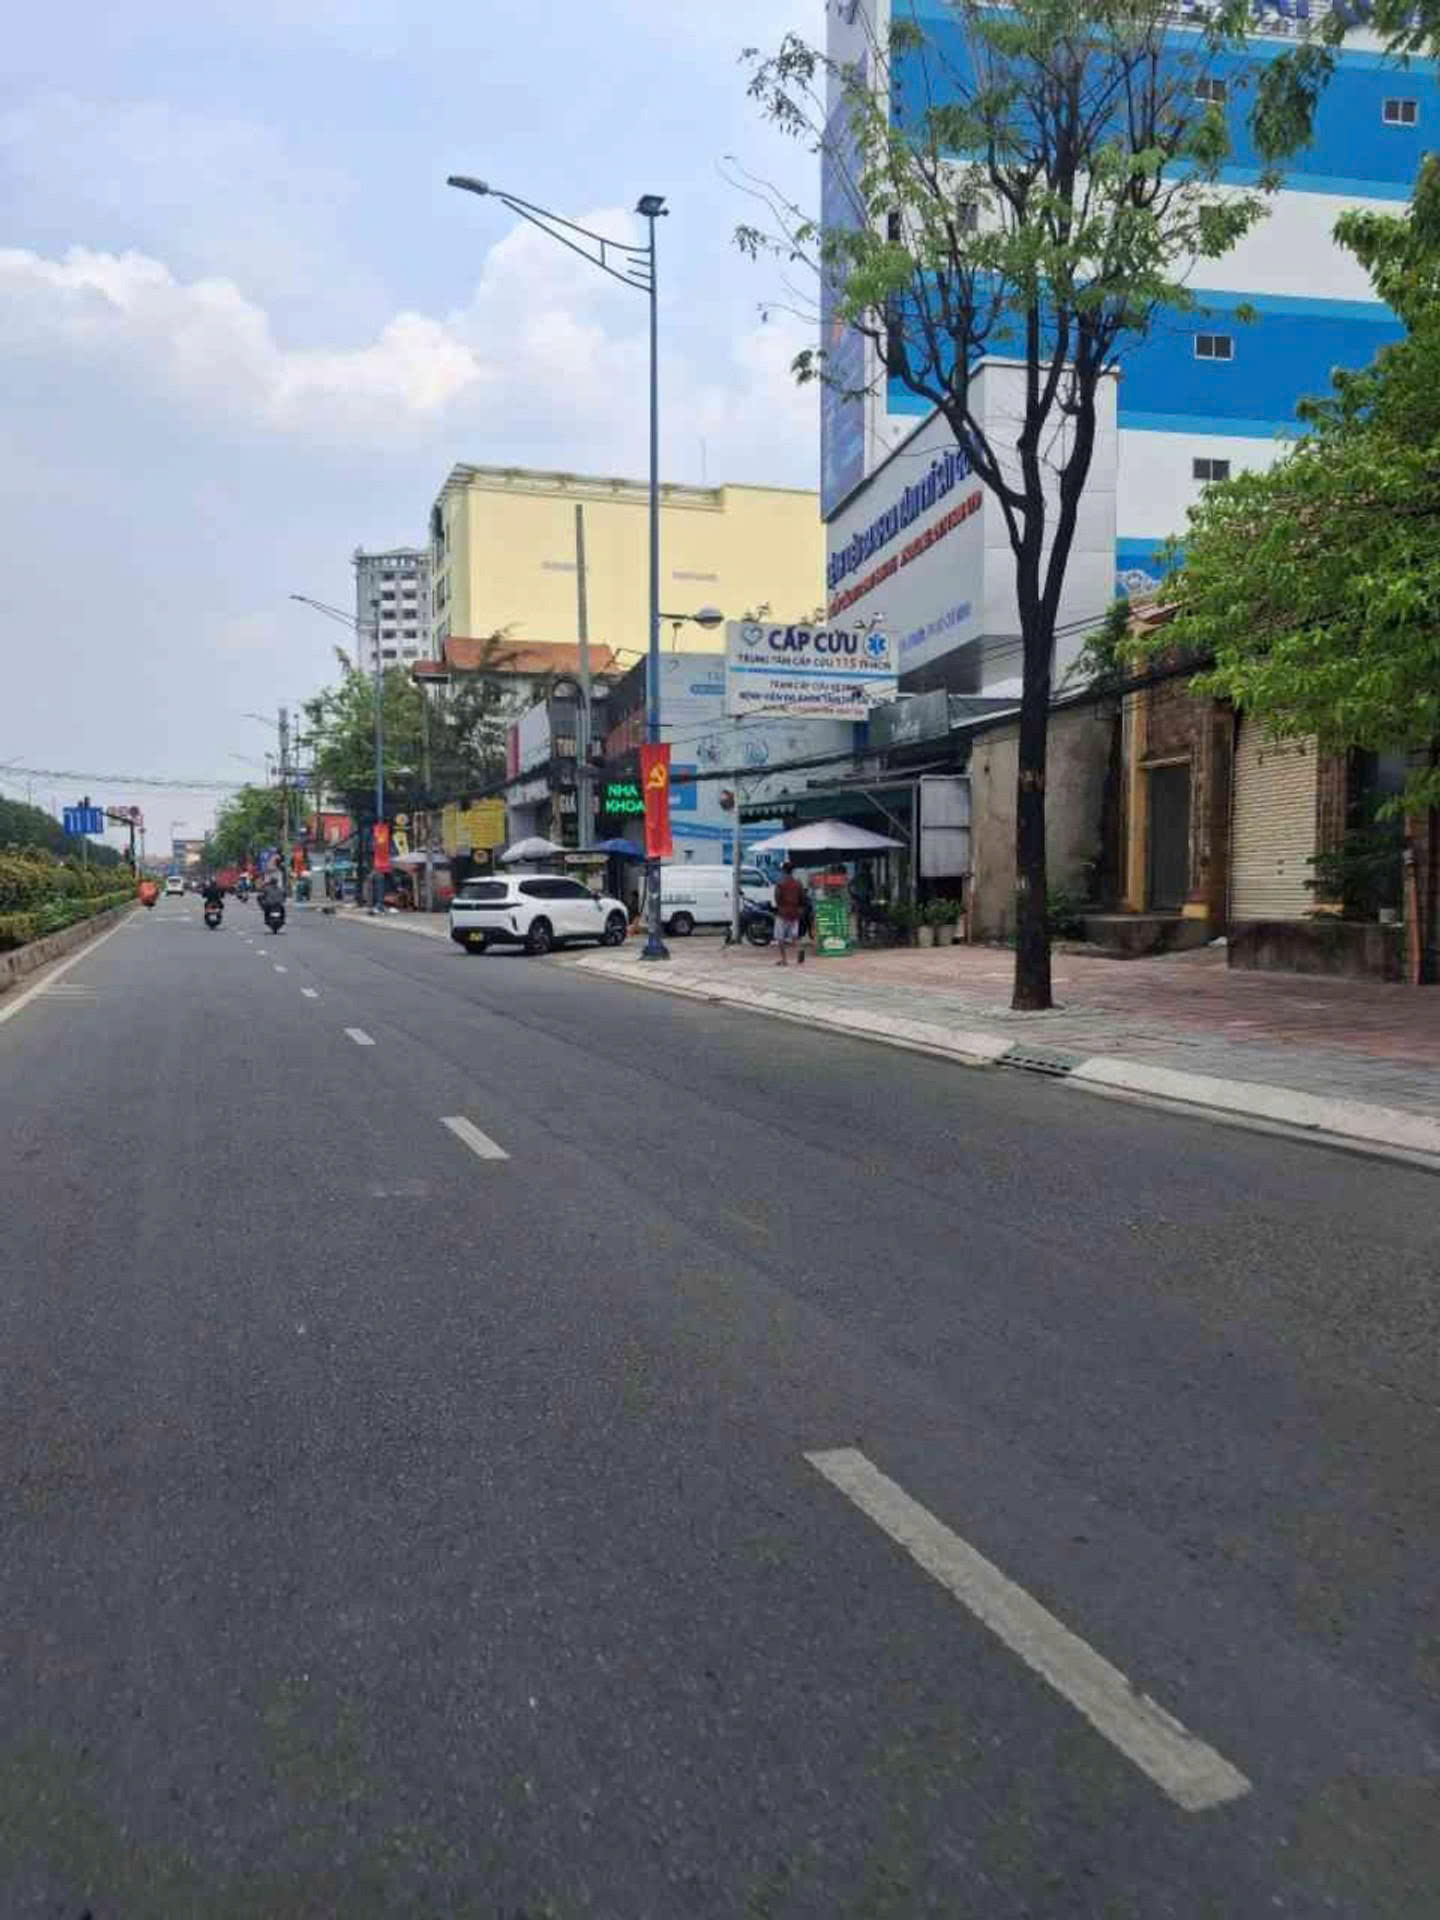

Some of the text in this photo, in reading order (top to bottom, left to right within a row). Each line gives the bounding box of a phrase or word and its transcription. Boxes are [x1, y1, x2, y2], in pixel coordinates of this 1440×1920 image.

[768, 625, 857, 654] CẤP CỨU
[792, 655, 811, 666] CẤP
[814, 656, 833, 668] CỨU
[608, 784, 638, 797] NHA
[606, 799, 645, 813] KHOA
